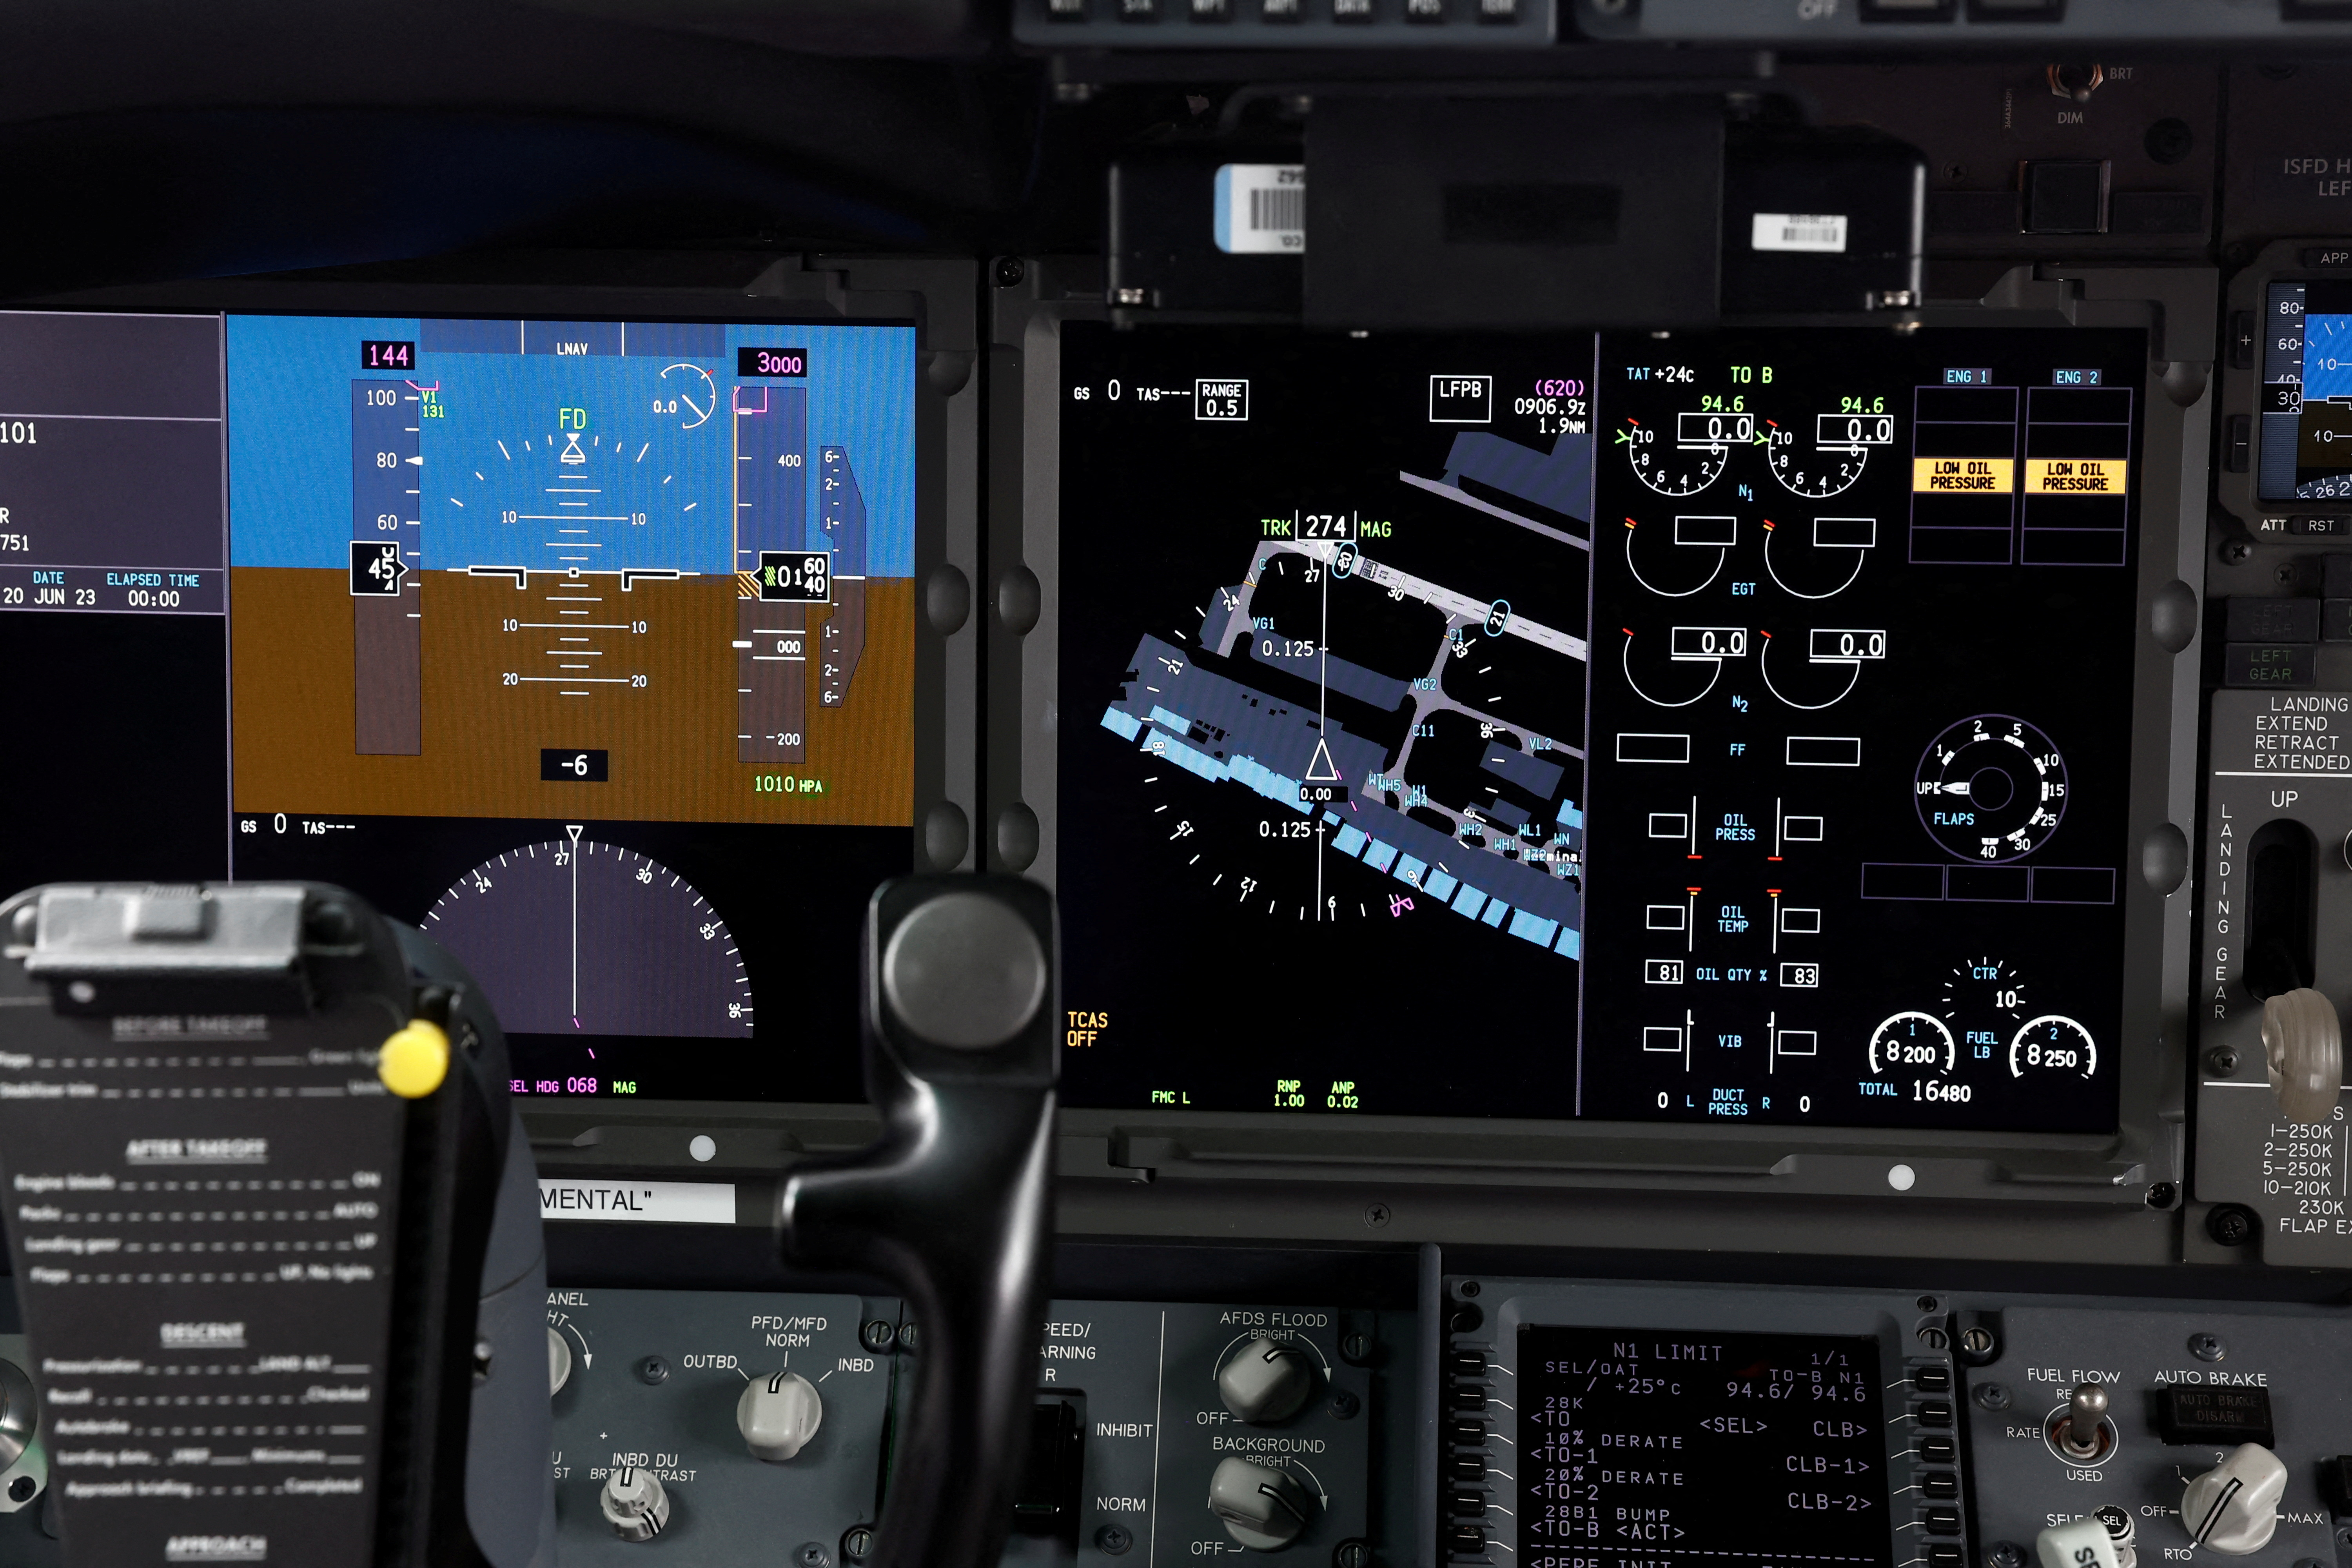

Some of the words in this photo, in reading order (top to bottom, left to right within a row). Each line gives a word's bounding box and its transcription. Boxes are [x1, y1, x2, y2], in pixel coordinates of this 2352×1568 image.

[2110, 67, 2133, 79] BRT
[2058, 111, 2083, 123] DIM
[2284, 158, 2328, 174] ISFD
[2321, 252, 2348, 263] APP
[370, 345, 408, 366] 144
[557, 342, 588, 356] LNAV
[758, 352, 802, 374] 3000
[1626, 367, 1650, 380] TAT
[1730, 366, 1751, 383] TO
[1762, 367, 1772, 383] B
[1947, 370, 1971, 383] ENG
[1981, 370, 1986, 383] 1
[2056, 370, 2081, 384] ENG
[2089, 371, 2098, 384] 2
[1074, 387, 1090, 400] GS
[1202, 383, 1241, 397] RANGE
[1440, 381, 1481, 398] LFPB
[1535, 379, 1584, 396] (620)
[367, 389, 396, 406] 100
[422, 391, 436, 403] V1
[1702, 395, 1744, 412] 94.6
[653, 400, 677, 414] 0.0
[1207, 399, 1238, 416] 0.5
[1841, 396, 1884, 414] 94.6
[560, 408, 586, 430] FD
[1708, 417, 1750, 439] 0.0
[778, 454, 801, 467] 400
[1935, 461, 1960, 474] LOW
[1967, 462, 1992, 475] OIL
[2048, 463, 2073, 475] LOW
[2080, 463, 2105, 476] OIL
[1931, 476, 1996, 490] PRESSURE
[2043, 477, 2109, 491] PRESSURE
[1261, 519, 1291, 536] TRK
[1306, 515, 1346, 537] 274
[1361, 521, 1391, 537] MAG
[2261, 519, 2287, 531] ATT
[2309, 520, 2334, 531] RST
[33, 571, 64, 584] DATE
[107, 573, 161, 586] ELAPSED
[169, 574, 200, 587] TIME
[1732, 582, 1756, 595] EGT
[3, 587, 24, 604] 20
[34, 588, 65, 604] JUN
[75, 589, 96, 605] 23
[128, 590, 180, 607] 00:00
[1253, 617, 1274, 629] VG1
[1449, 629, 1463, 641] C1
[1262, 640, 1314, 657] 0.125
[2251, 650, 2291, 662] LEFT
[2249, 668, 2291, 681] GEAR
[1414, 679, 1436, 690] VG2
[2271, 697, 2348, 712] LANDING
[2256, 715, 2328, 731] EXTEND
[1412, 725, 1434, 737] C11
[1529, 738, 1552, 750] VL2
[1730, 743, 1746, 756] FF
[2256, 735, 2339, 750] RETRACT
[2255, 754, 2350, 769] EXTENDED
[755, 775, 794, 792] 1010
[799, 779, 822, 793] HPA
[1916, 782, 1933, 795] UP
[2272, 790, 2298, 808] UP
[1724, 813, 1748, 826] OIL
[1934, 812, 1974, 826] FLAPS
[241, 820, 257, 833] GS
[1459, 823, 1483, 835] WH2
[1519, 824, 1541, 836] WL1
[1554, 833, 1570, 845] WN
[1716, 828, 1755, 841] PRESS
[1494, 839, 1516, 850] WH1
[1557, 864, 1579, 876] WZ1
[1722, 905, 1745, 918] OIL
[1718, 920, 1749, 933] TEMP
[1660, 964, 1679, 981] 81
[1697, 967, 1720, 980] OIL
[1728, 968, 1751, 981] QTY
[1795, 968, 1815, 984] 83
[1973, 967, 1997, 980] CTR
[1068, 1011, 1108, 1028] TCAS
[1067, 1030, 1098, 1047] OFF
[1719, 1034, 1742, 1047] VIB
[1967, 1031, 1998, 1044] FUEL
[1974, 1045, 1990, 1058] LB
[536, 1080, 559, 1093] HDG
[567, 1077, 597, 1093] 068
[613, 1081, 636, 1094] MAG
[1277, 1080, 1301, 1093] RNP
[1331, 1081, 1355, 1094] ANP
[1858, 1082, 1898, 1096] TOTAL
[1152, 1091, 1175, 1103] FMC
[1183, 1091, 1191, 1104] L
[1274, 1094, 1305, 1107] 1.00
[1713, 1088, 1744, 1101] DUCT
[1327, 1095, 1359, 1109] 0.02
[1709, 1102, 1748, 1116] PRESS
[2271, 1123, 2333, 1139] 1-250K
[2264, 1142, 2332, 1158] 2-250K
[2263, 1161, 2332, 1177] 5-250K
[2264, 1180, 2331, 1196] 10-210K
[2299, 1200, 2344, 1215] 230K
[2280, 1218, 2328, 1233] FLAP
[751, 1316, 827, 1330] PFD/MFD
[1220, 1311, 1265, 1325] AFDS
[1272, 1313, 1327, 1327] FLOOD
[766, 1334, 810, 1347] NORM
[1250, 1329, 1295, 1340] BRIGHT
[1614, 1342, 1639, 1358] N1
[1656, 1344, 1722, 1361] LIMIT
[684, 1354, 737, 1369] OUTBD
[838, 1358, 874, 1372] INBD
[1546, 1359, 1638, 1376] SEL/OAT
[1769, 1369, 1821, 1383] TO-B
[1840, 1372, 1864, 1384] N1
[2027, 1368, 2065, 1382] FUEL
[2072, 1370, 2121, 1383] FLOW
[2154, 1370, 2201, 1384] AUTO
[2209, 1372, 2267, 1387] BRAKE
[1545, 1396, 1583, 1409] 28K
[2180, 1394, 2210, 1405] AUTO
[2219, 1395, 2259, 1406] BRAKE
[1197, 1412, 1229, 1425] OFF
[2198, 1412, 2245, 1423] DISARM
[1097, 1423, 1153, 1437] INHIBIT
[2007, 1426, 2040, 1439] RATE
[1213, 1436, 1325, 1453] BACKGROUND
[1546, 1429, 1583, 1445] 10%
[1602, 1434, 1682, 1449] DERATE
[612, 1452, 649, 1466] INBD
[656, 1453, 678, 1467] DU
[1545, 1466, 1584, 1481] 20%
[1602, 1470, 1683, 1485] DERATE
[2067, 1469, 2103, 1482] USED
[1097, 1497, 1145, 1512] NORM
[2140, 1505, 2167, 1517] OFF
[1546, 1505, 1598, 1519] 28B1
[1617, 1508, 1669, 1521] BUMP
[2288, 1512, 2323, 1524] MAX
[2103, 1515, 2121, 1526] SEL
[1191, 1541, 1224, 1555] OFF
[2164, 1548, 2192, 1560] RTO
